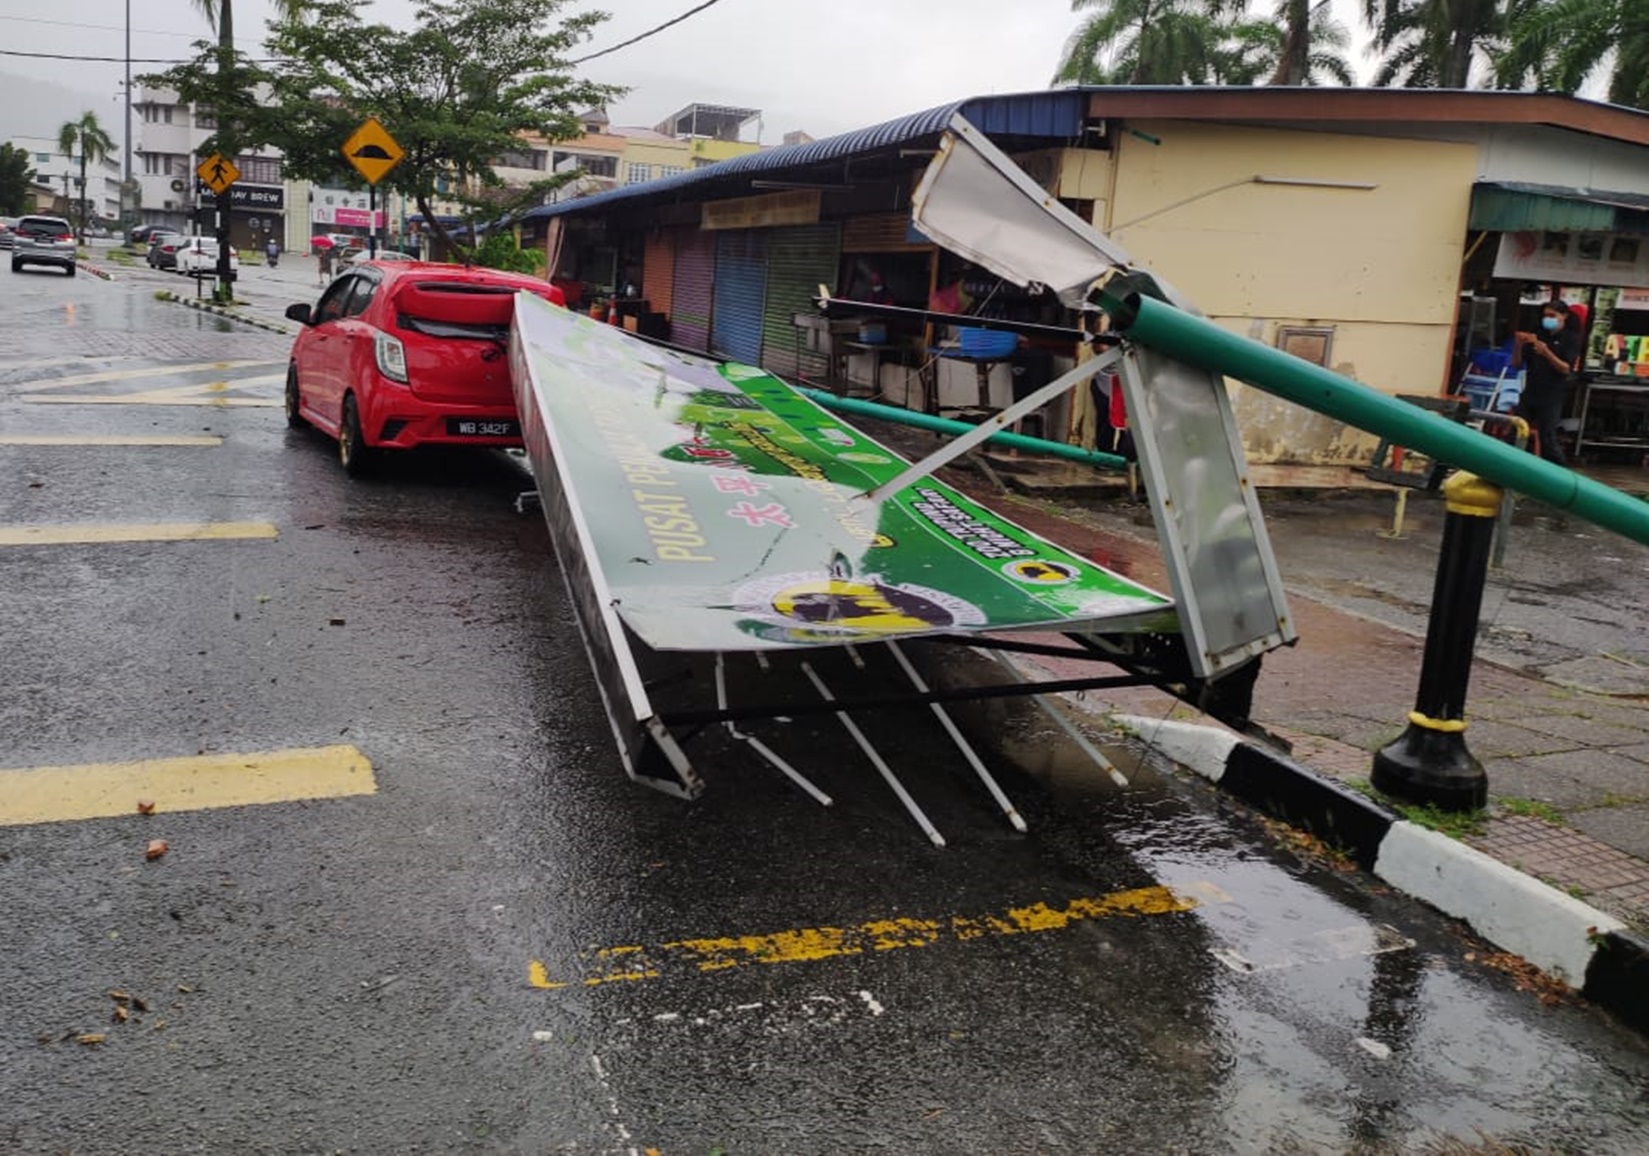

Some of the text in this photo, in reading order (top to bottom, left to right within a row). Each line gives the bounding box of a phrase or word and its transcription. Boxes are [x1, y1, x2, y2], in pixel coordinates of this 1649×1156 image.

[250, 192, 279, 203] BREW
[459, 422, 476, 434] WB
[632, 489, 715, 561] PUSAT
